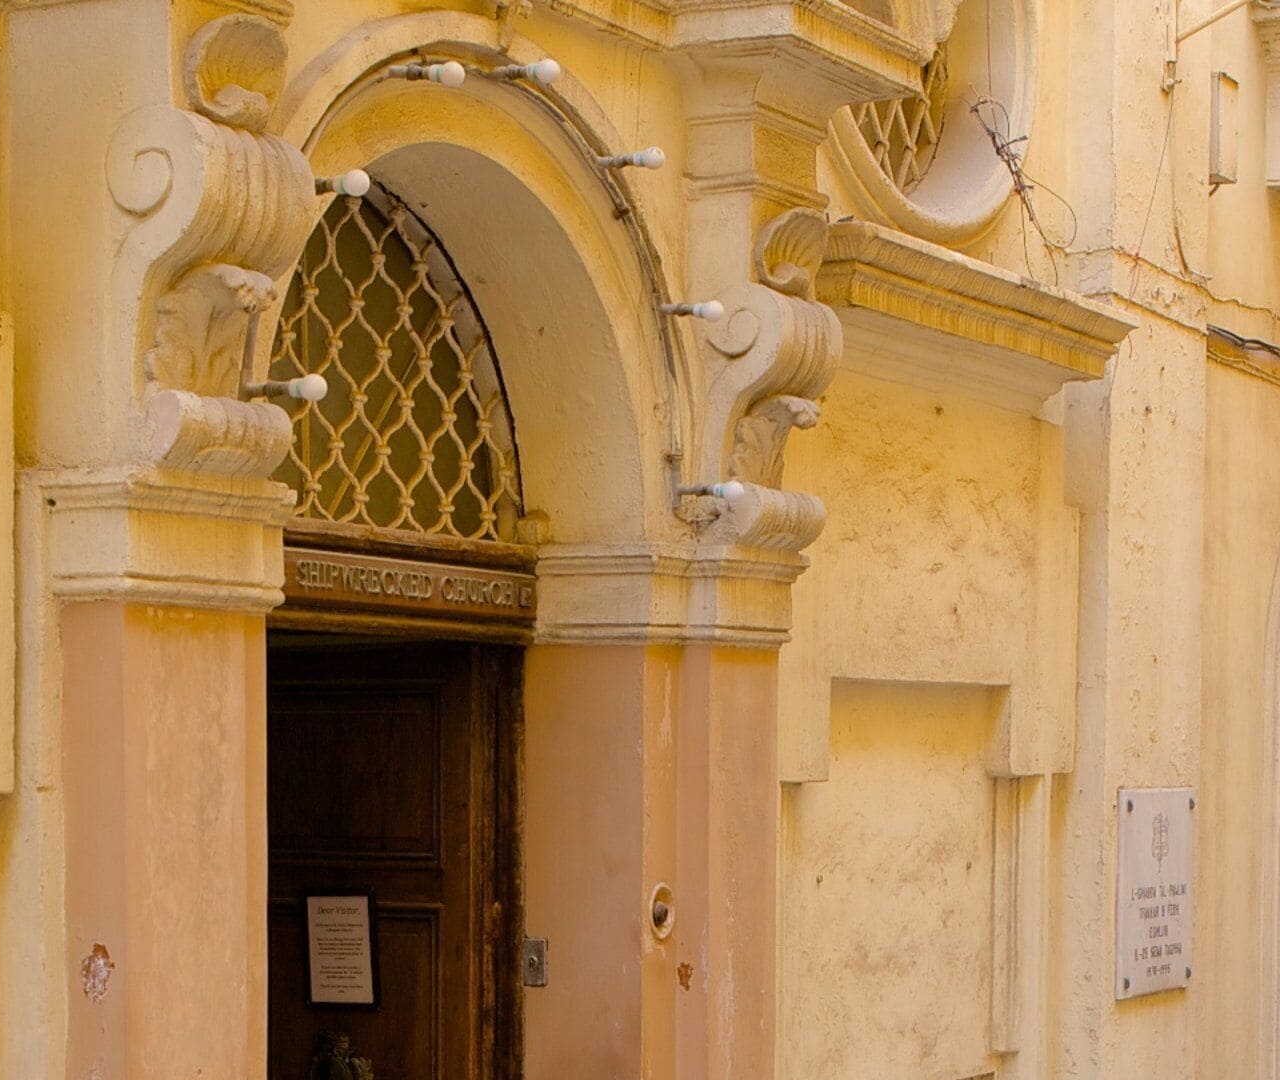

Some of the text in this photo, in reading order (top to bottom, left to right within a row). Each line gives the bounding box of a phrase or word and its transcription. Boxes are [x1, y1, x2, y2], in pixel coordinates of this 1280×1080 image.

[295, 559, 433, 600] SHIPWRECKED
[440, 575, 515, 607] CHURCH
[316, 905, 335, 916] Dear
